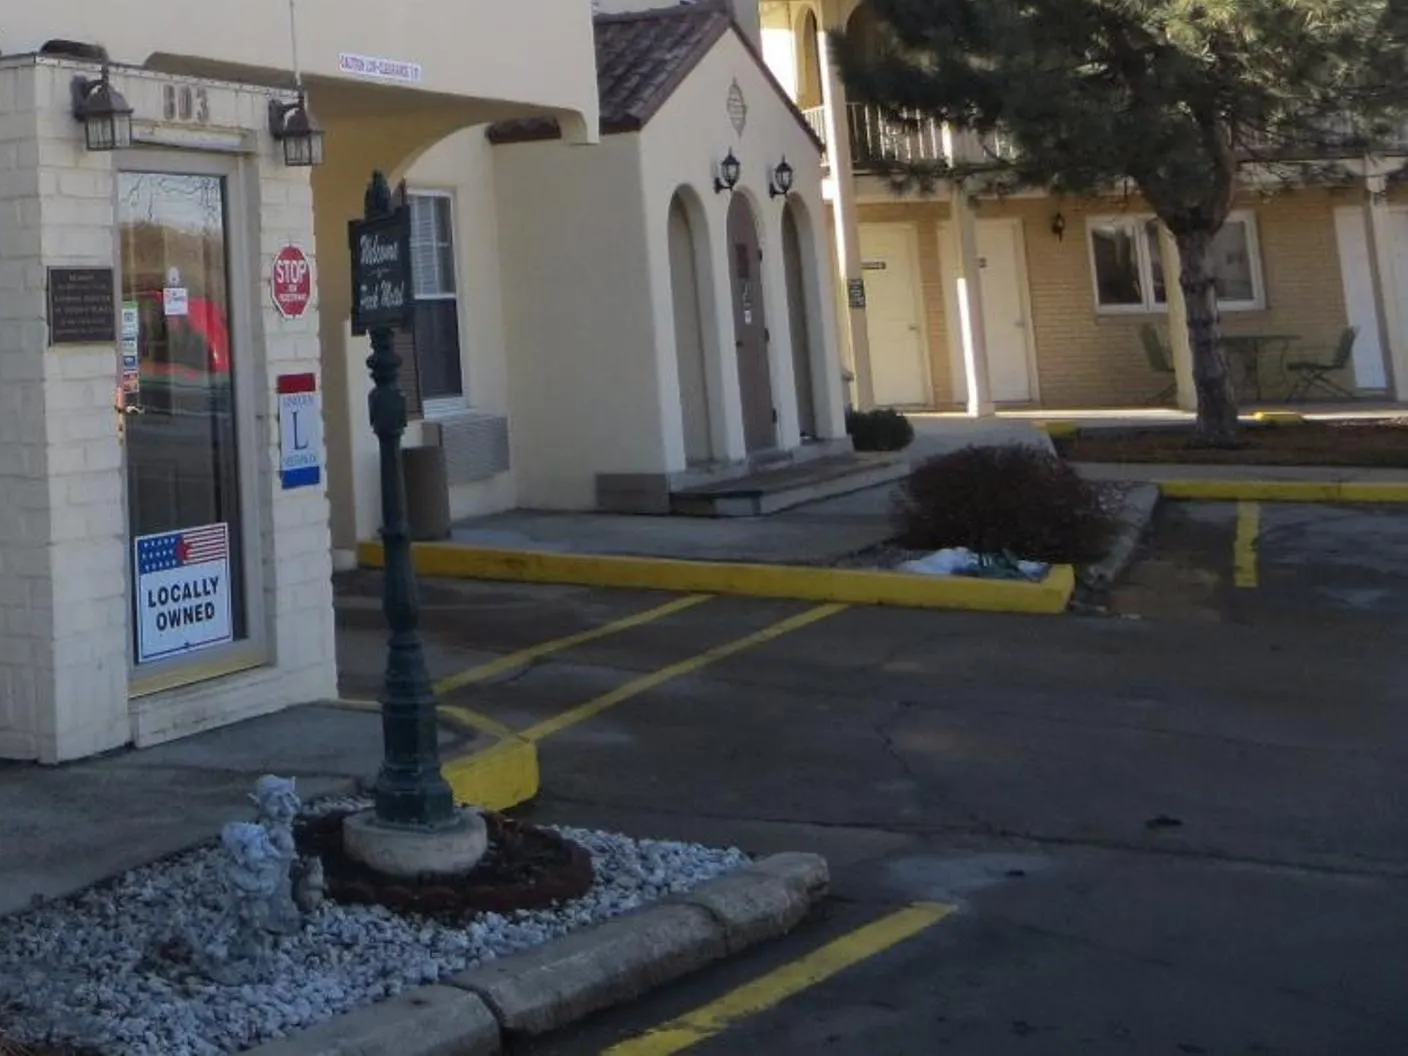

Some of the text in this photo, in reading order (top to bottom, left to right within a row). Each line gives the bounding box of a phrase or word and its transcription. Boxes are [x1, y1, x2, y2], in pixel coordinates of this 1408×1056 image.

[275, 259, 308, 284] STOP
[290, 411, 310, 451] L
[147, 575, 220, 608] LOCALLY
[156, 601, 215, 632] OWNED
